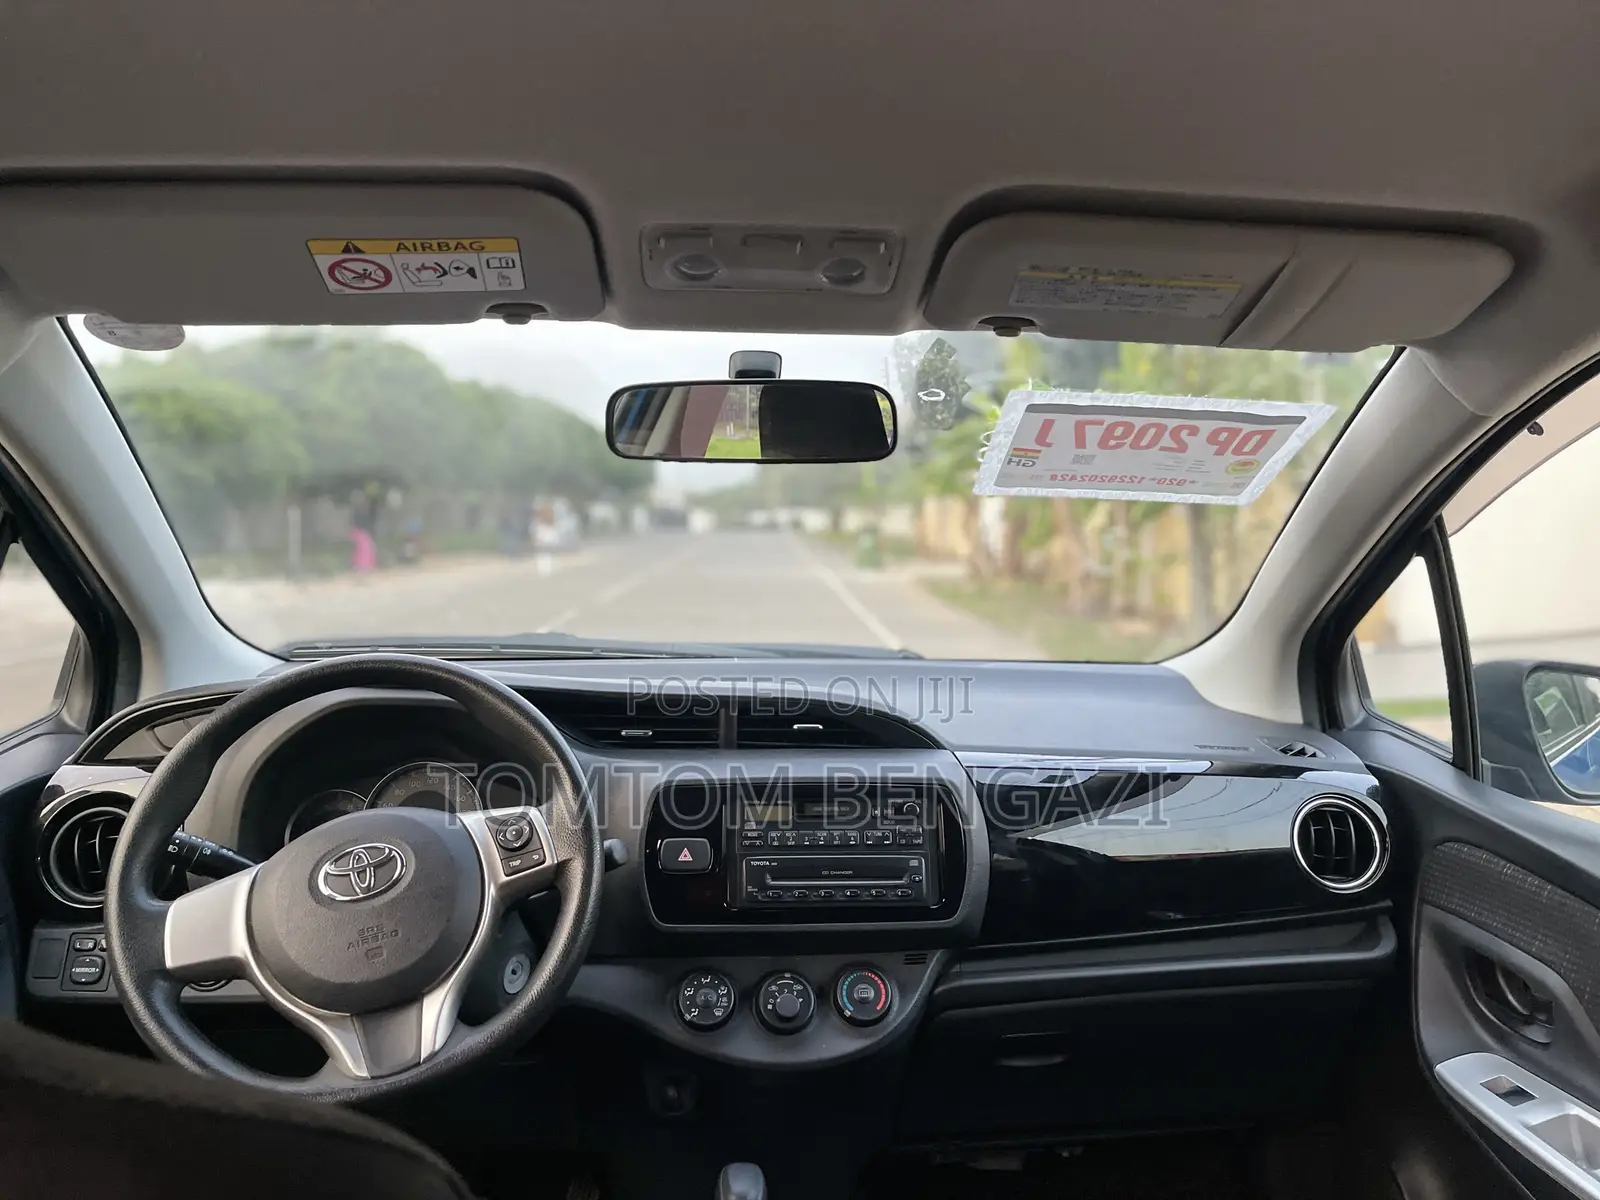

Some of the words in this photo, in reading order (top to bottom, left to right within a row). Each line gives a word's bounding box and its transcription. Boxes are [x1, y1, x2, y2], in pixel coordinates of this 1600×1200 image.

[395, 241, 485, 252] AIRBAG
[508, 859, 522, 868] TRIP
[346, 929, 399, 950] AIRBAG
